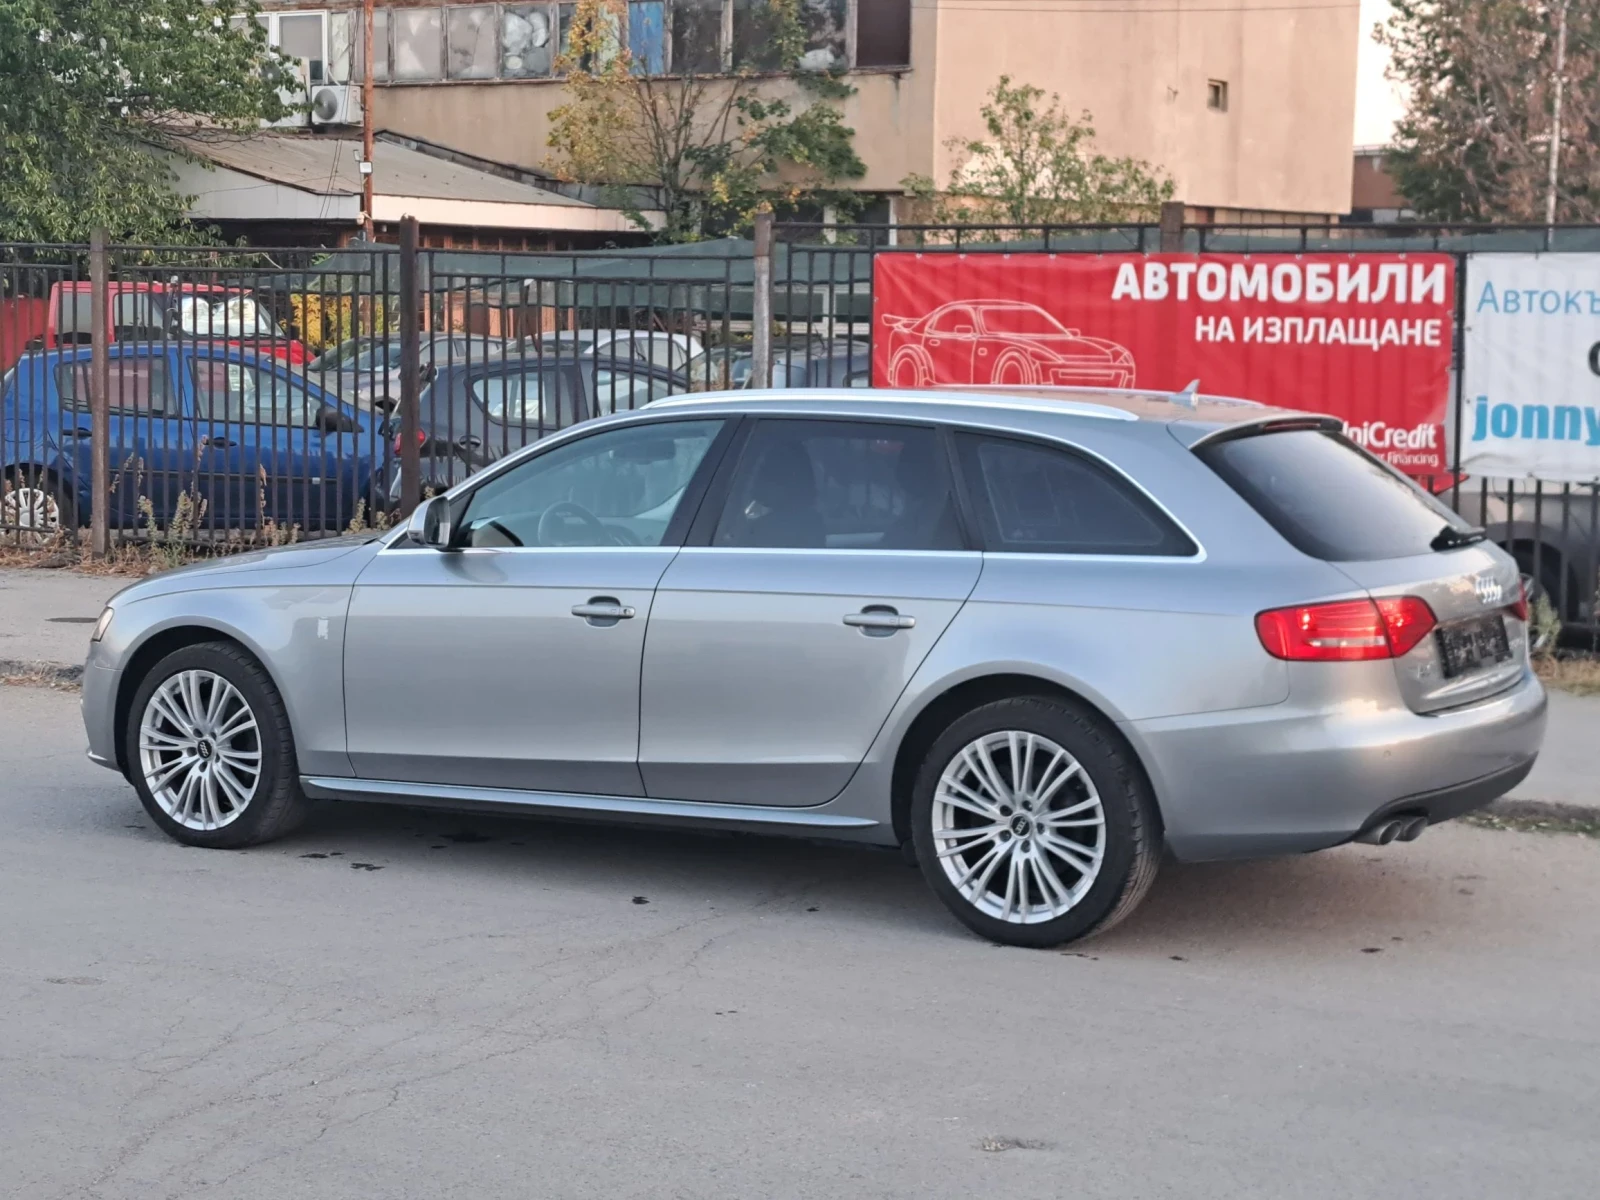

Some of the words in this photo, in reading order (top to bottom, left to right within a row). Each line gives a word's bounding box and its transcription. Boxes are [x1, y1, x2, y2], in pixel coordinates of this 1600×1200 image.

[1111, 262, 1446, 304] АВТОМОБИЛИ
[1195, 316, 1234, 343] НА
[1243, 317, 1442, 351] ИЗПЛАЩАНЕ
